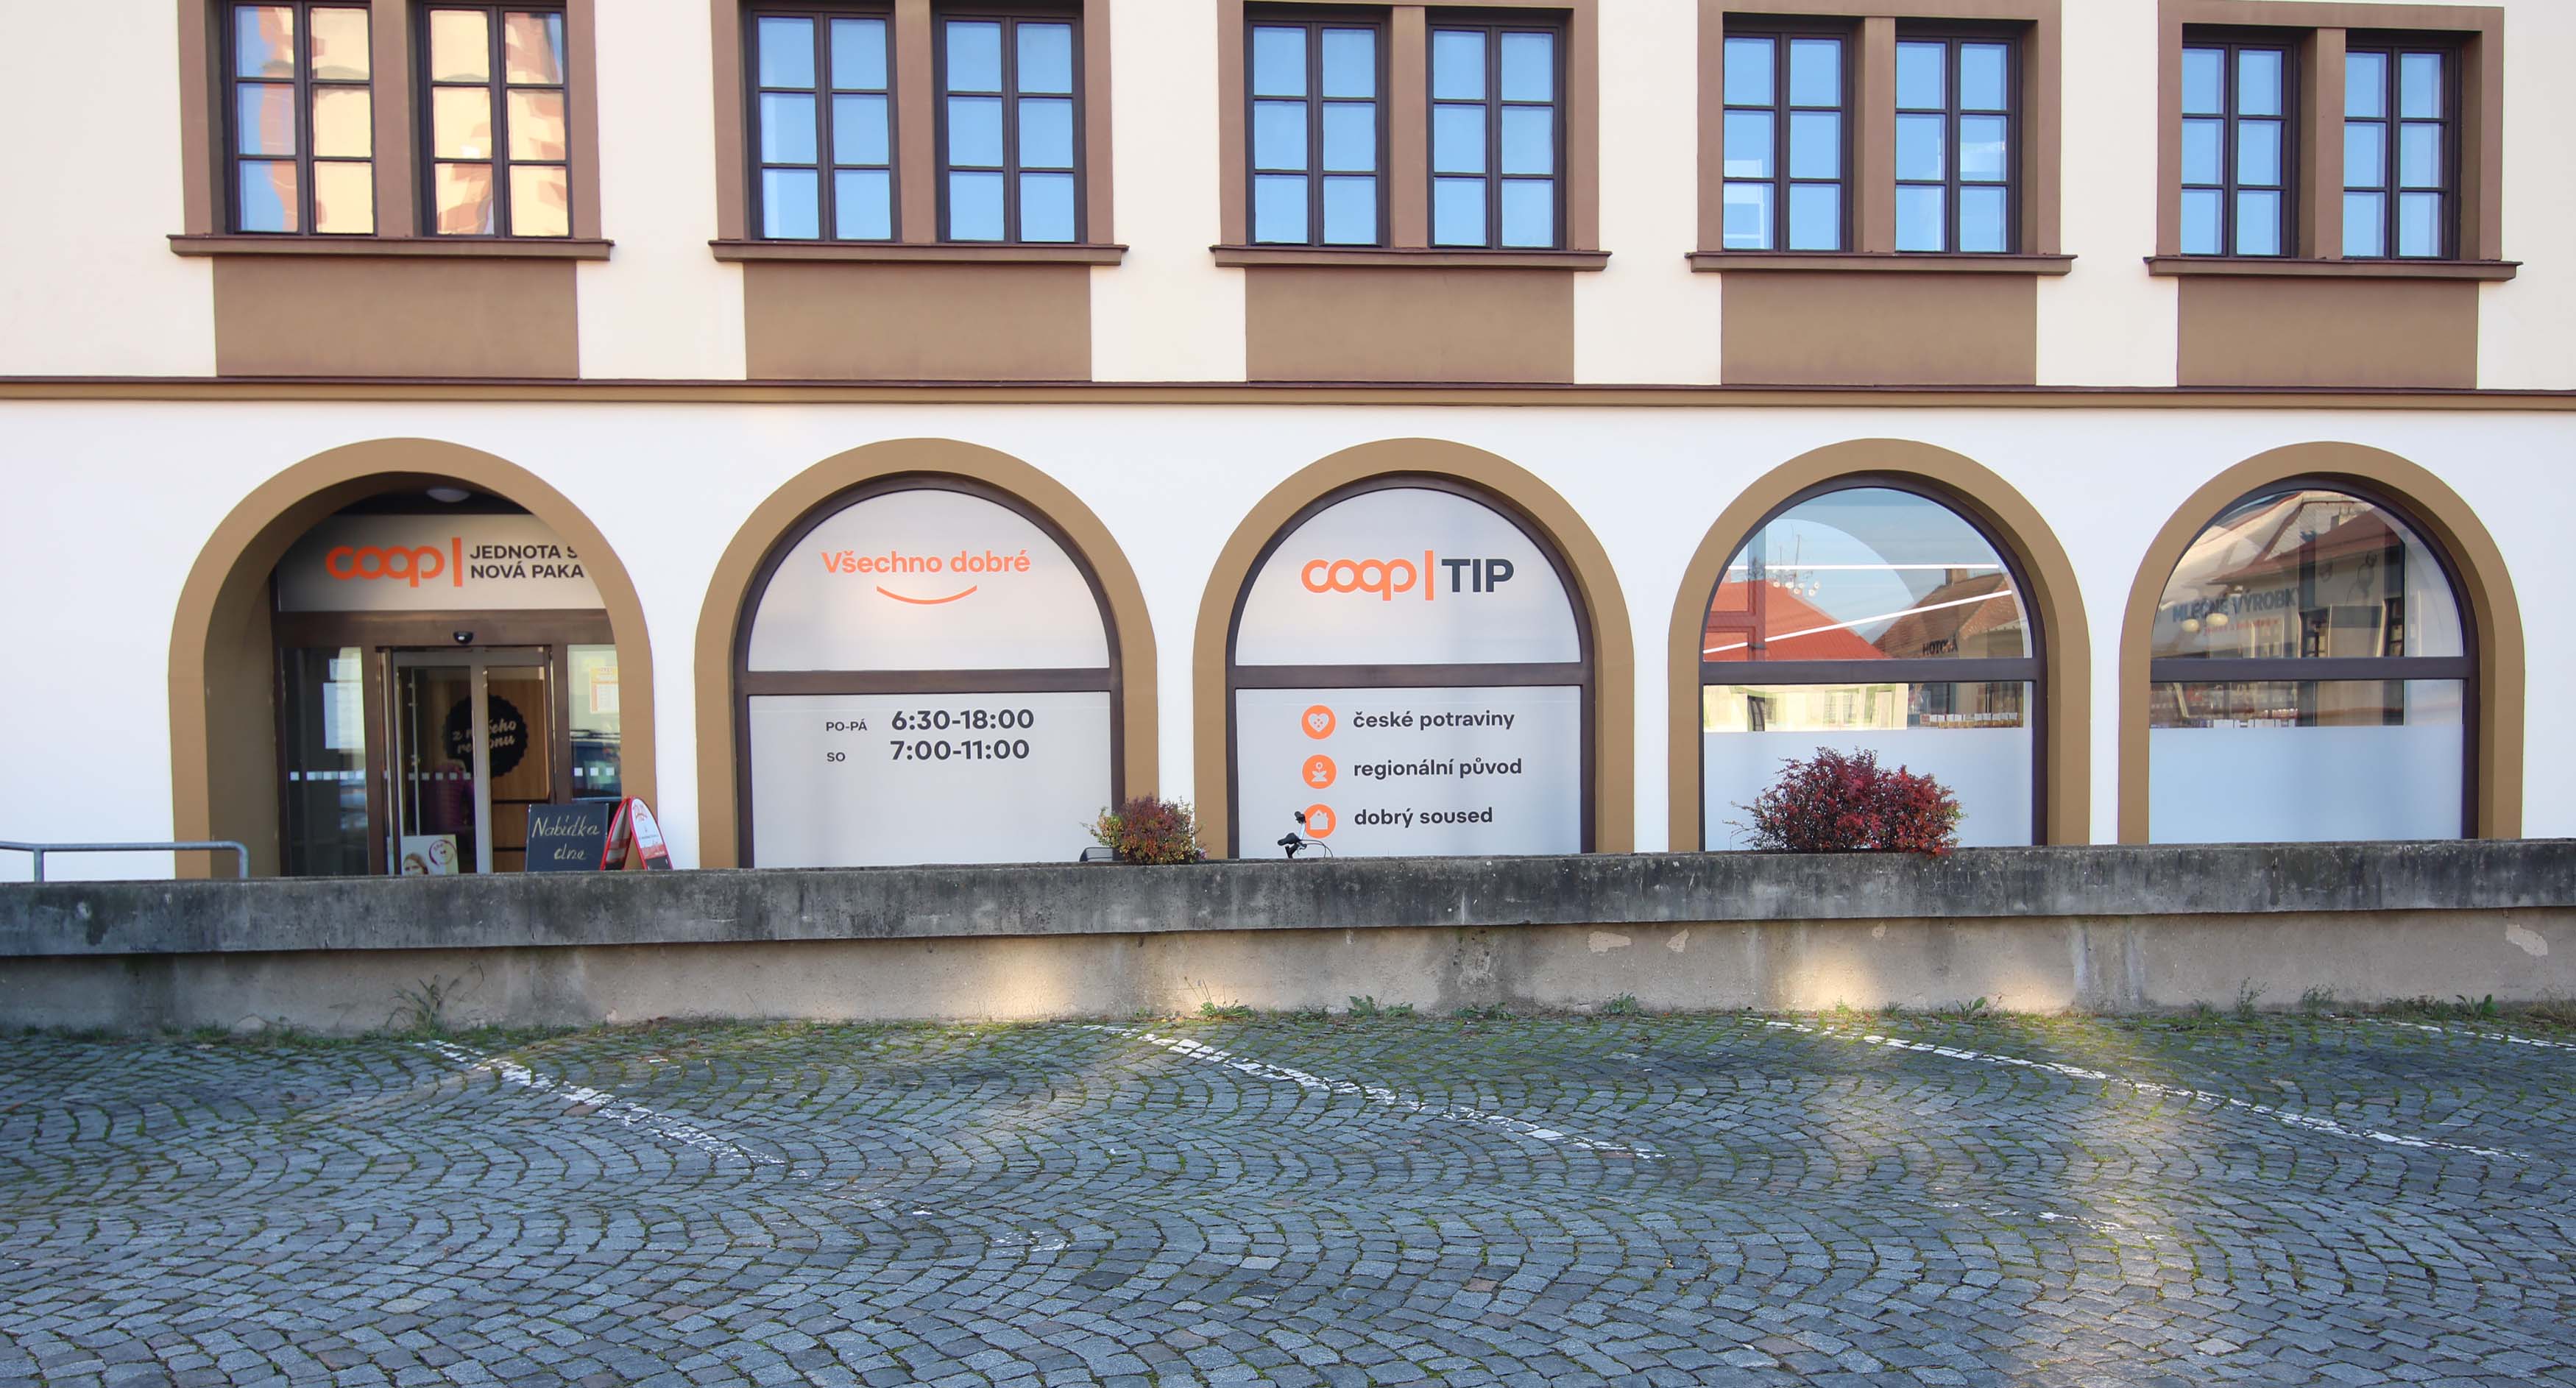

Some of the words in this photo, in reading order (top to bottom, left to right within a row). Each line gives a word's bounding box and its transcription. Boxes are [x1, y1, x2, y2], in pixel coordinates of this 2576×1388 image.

[470, 545, 561, 559] JEDNOTA
[821, 550, 943, 573] Všechno
[950, 550, 1031, 573] dobré
[470, 561, 526, 578] NOVÁ
[531, 564, 584, 578] PAKA
[1441, 559, 1515, 592] TIP
[825, 718, 868, 732] PO-PÁ
[891, 709, 1035, 731] 6:30-18:00
[1353, 710, 1414, 728] české
[1420, 709, 1515, 731] potraviny
[826, 751, 846, 762] SO
[890, 739, 1030, 760] 7:00-11:00
[1354, 759, 1455, 780] regionální
[1459, 757, 1522, 779] původ
[531, 813, 601, 838] Nabídka
[1354, 808, 1414, 829] dobrý
[1419, 807, 1493, 824] soused
[553, 843, 588, 860] dne
